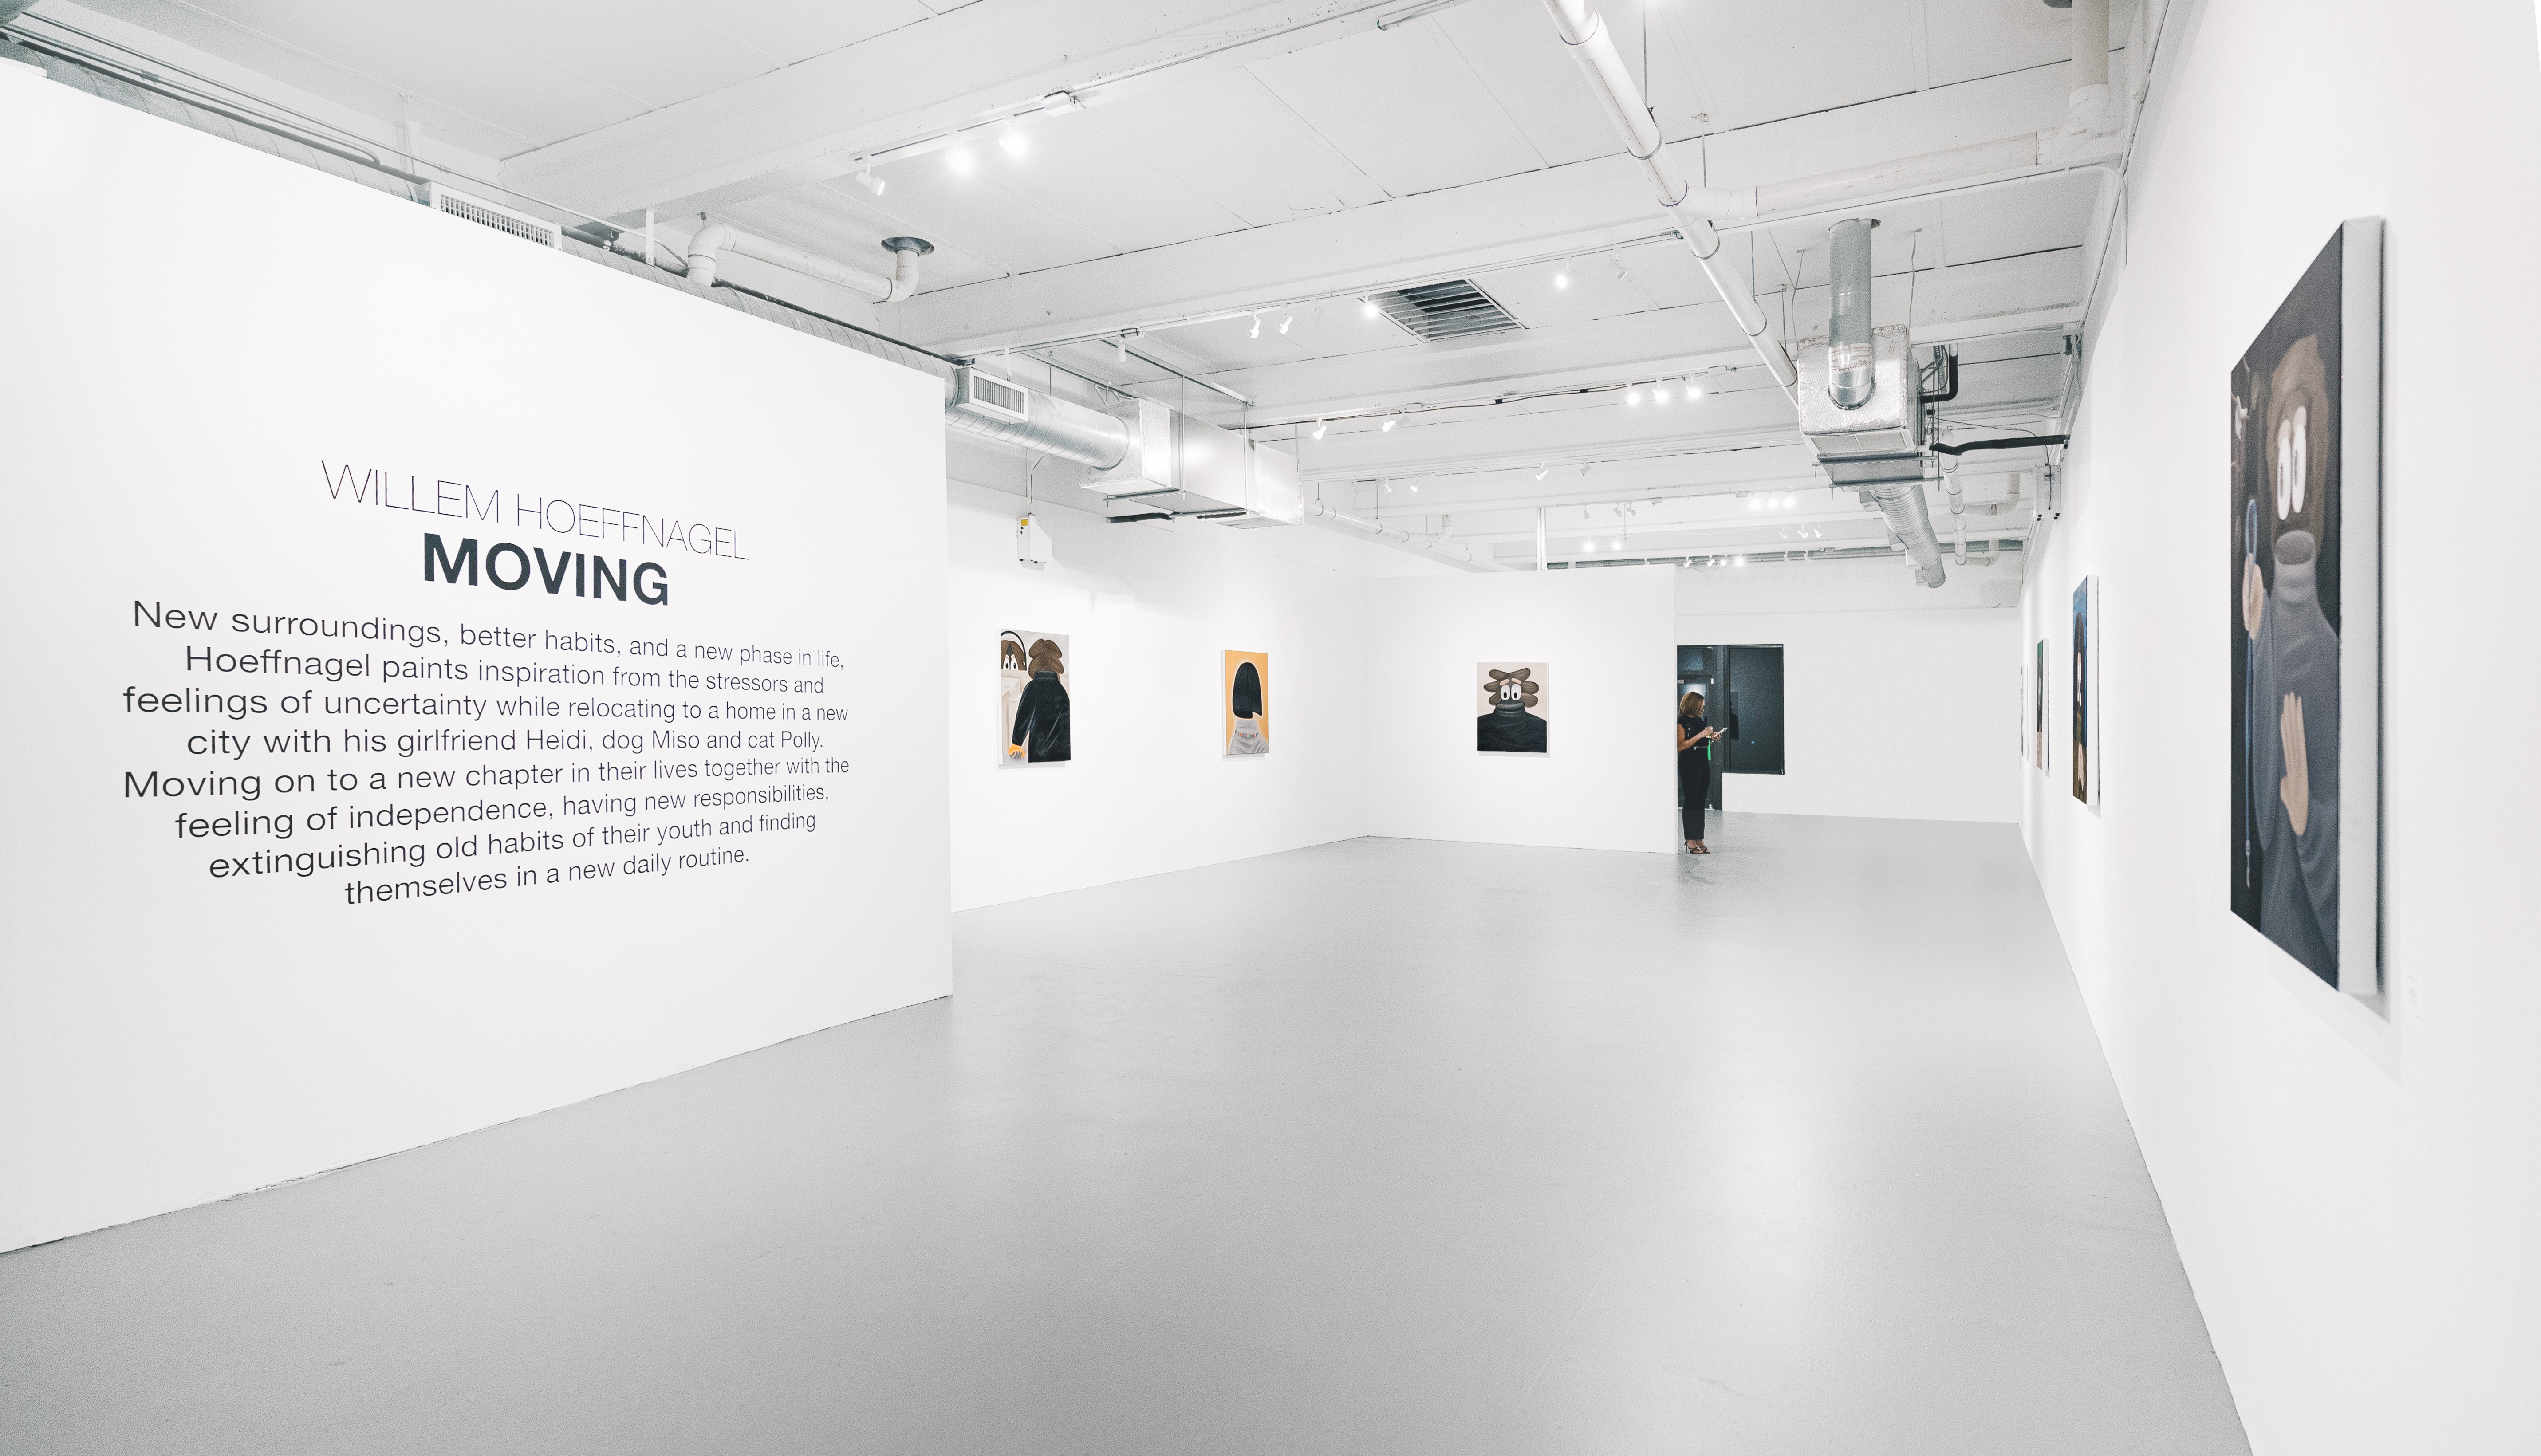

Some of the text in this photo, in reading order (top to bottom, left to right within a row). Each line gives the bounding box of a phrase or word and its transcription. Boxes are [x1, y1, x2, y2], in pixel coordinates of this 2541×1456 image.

[321, 460, 749, 560] WILLEM HOEFFNAGEL
[424, 532, 668, 606] MOVING
[134, 600, 843, 670] New surroundings, better habits, and a new phase in life,
[186, 645, 823, 694] Hoeffnagel paints inspiration from the stressors and
[122, 686, 848, 724] feelings of uncertainty while relocating to a home in a new
[187, 728, 823, 761] city with his girlfriend Heidi, dog Miso and cat Polly.
[125, 756, 849, 801] Moving on to a new chapter in their lives together with the
[174, 784, 828, 840] feeling of independence, having new responsibilities,
[209, 812, 815, 878] extinguishing old habits of their youth and finding
[344, 846, 749, 905] themselves in a new daily routine.
